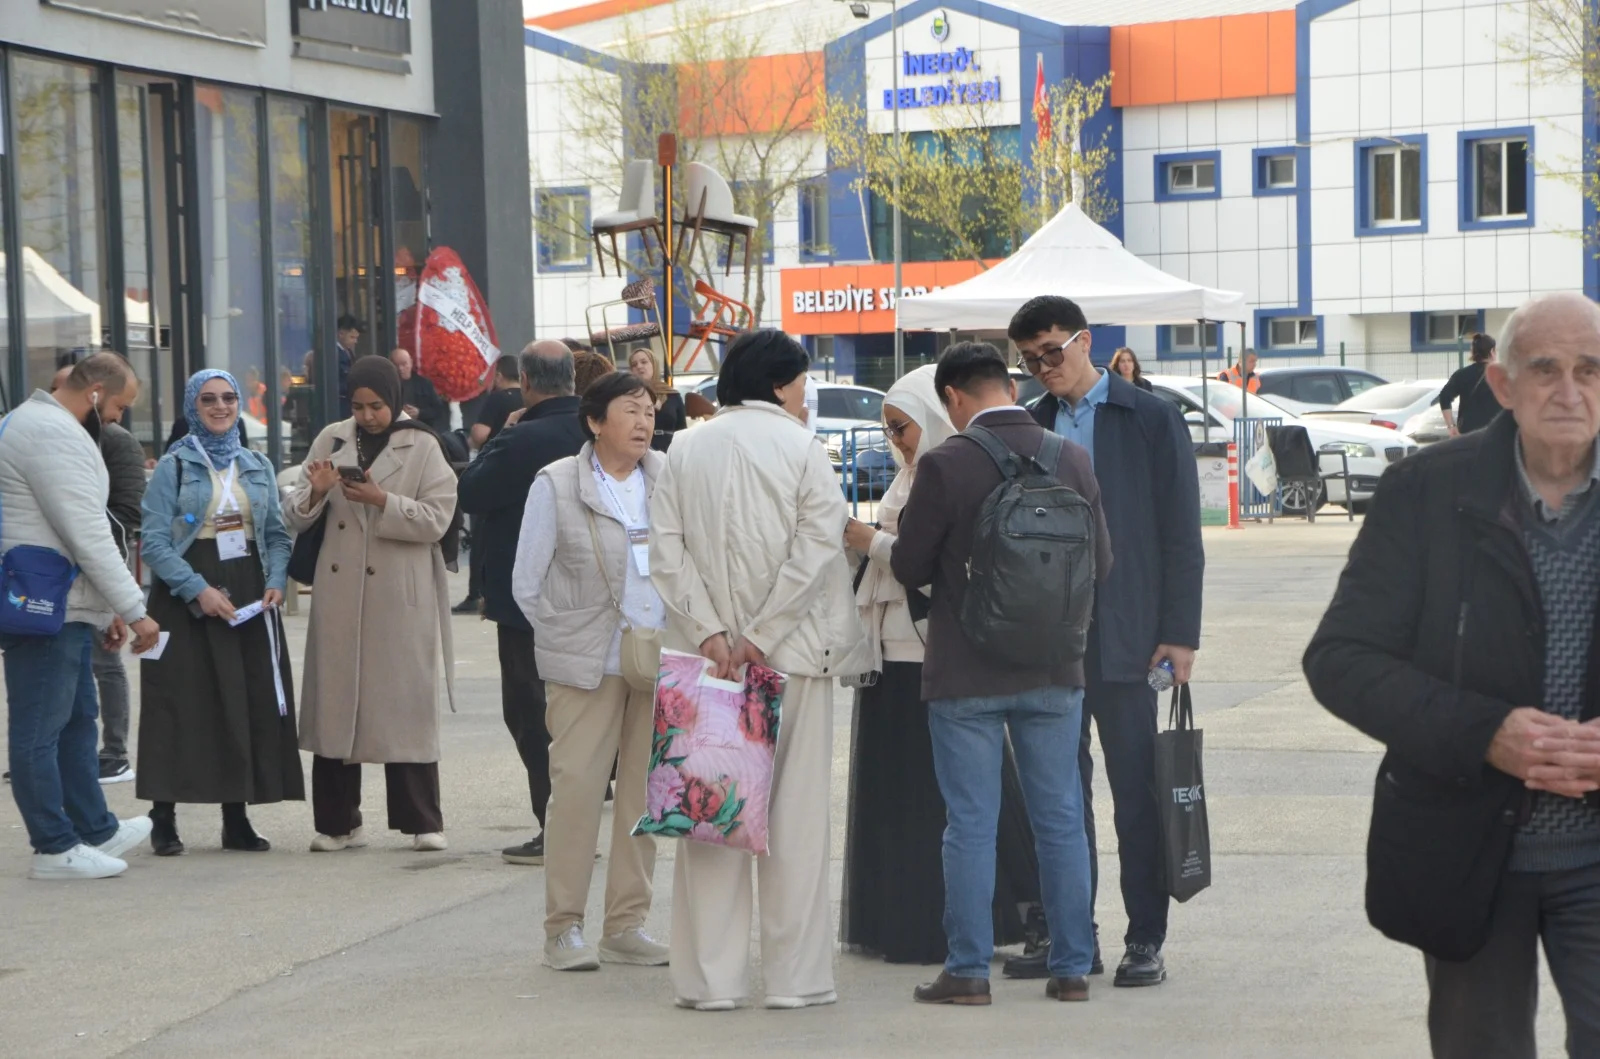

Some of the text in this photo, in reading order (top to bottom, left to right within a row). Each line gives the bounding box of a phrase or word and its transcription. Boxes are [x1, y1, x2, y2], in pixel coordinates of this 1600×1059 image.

[883, 76, 1001, 110] BELEDİYESİ
[793, 284, 876, 314] BELEDİYE
[450, 307, 473, 330] HELP
